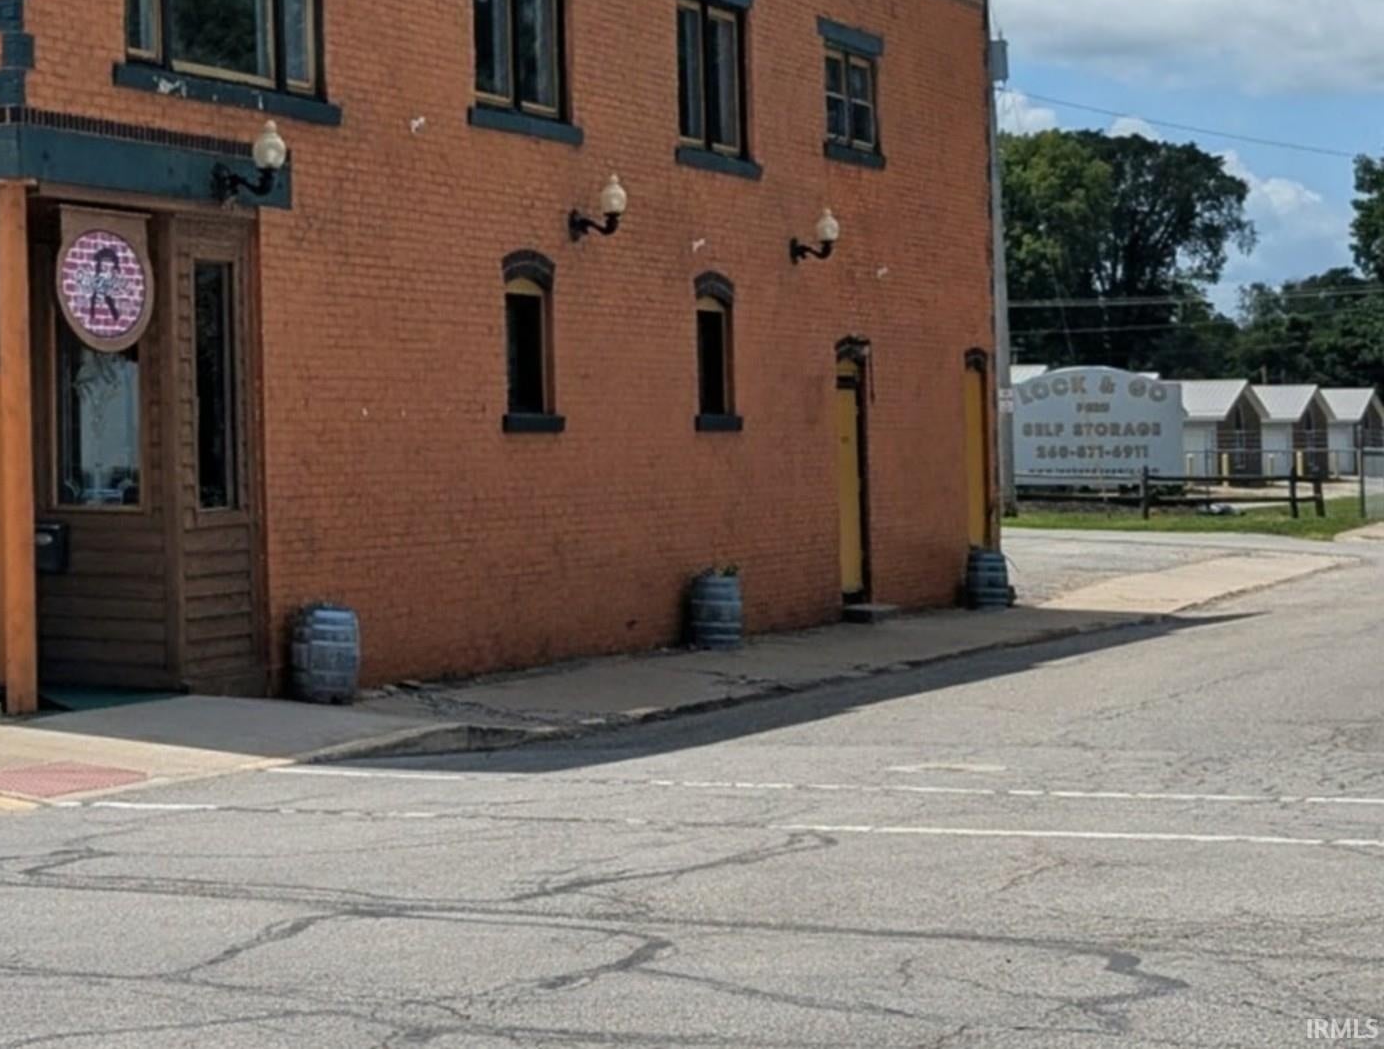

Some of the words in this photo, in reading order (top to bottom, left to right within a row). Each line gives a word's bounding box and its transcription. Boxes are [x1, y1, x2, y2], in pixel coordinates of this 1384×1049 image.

[1019, 375, 1087, 405] LOCK
[1099, 375, 1115, 394] &
[1128, 379, 1167, 402] GO
[1023, 422, 1065, 437] SELF
[1073, 422, 1162, 437] STORAGE
